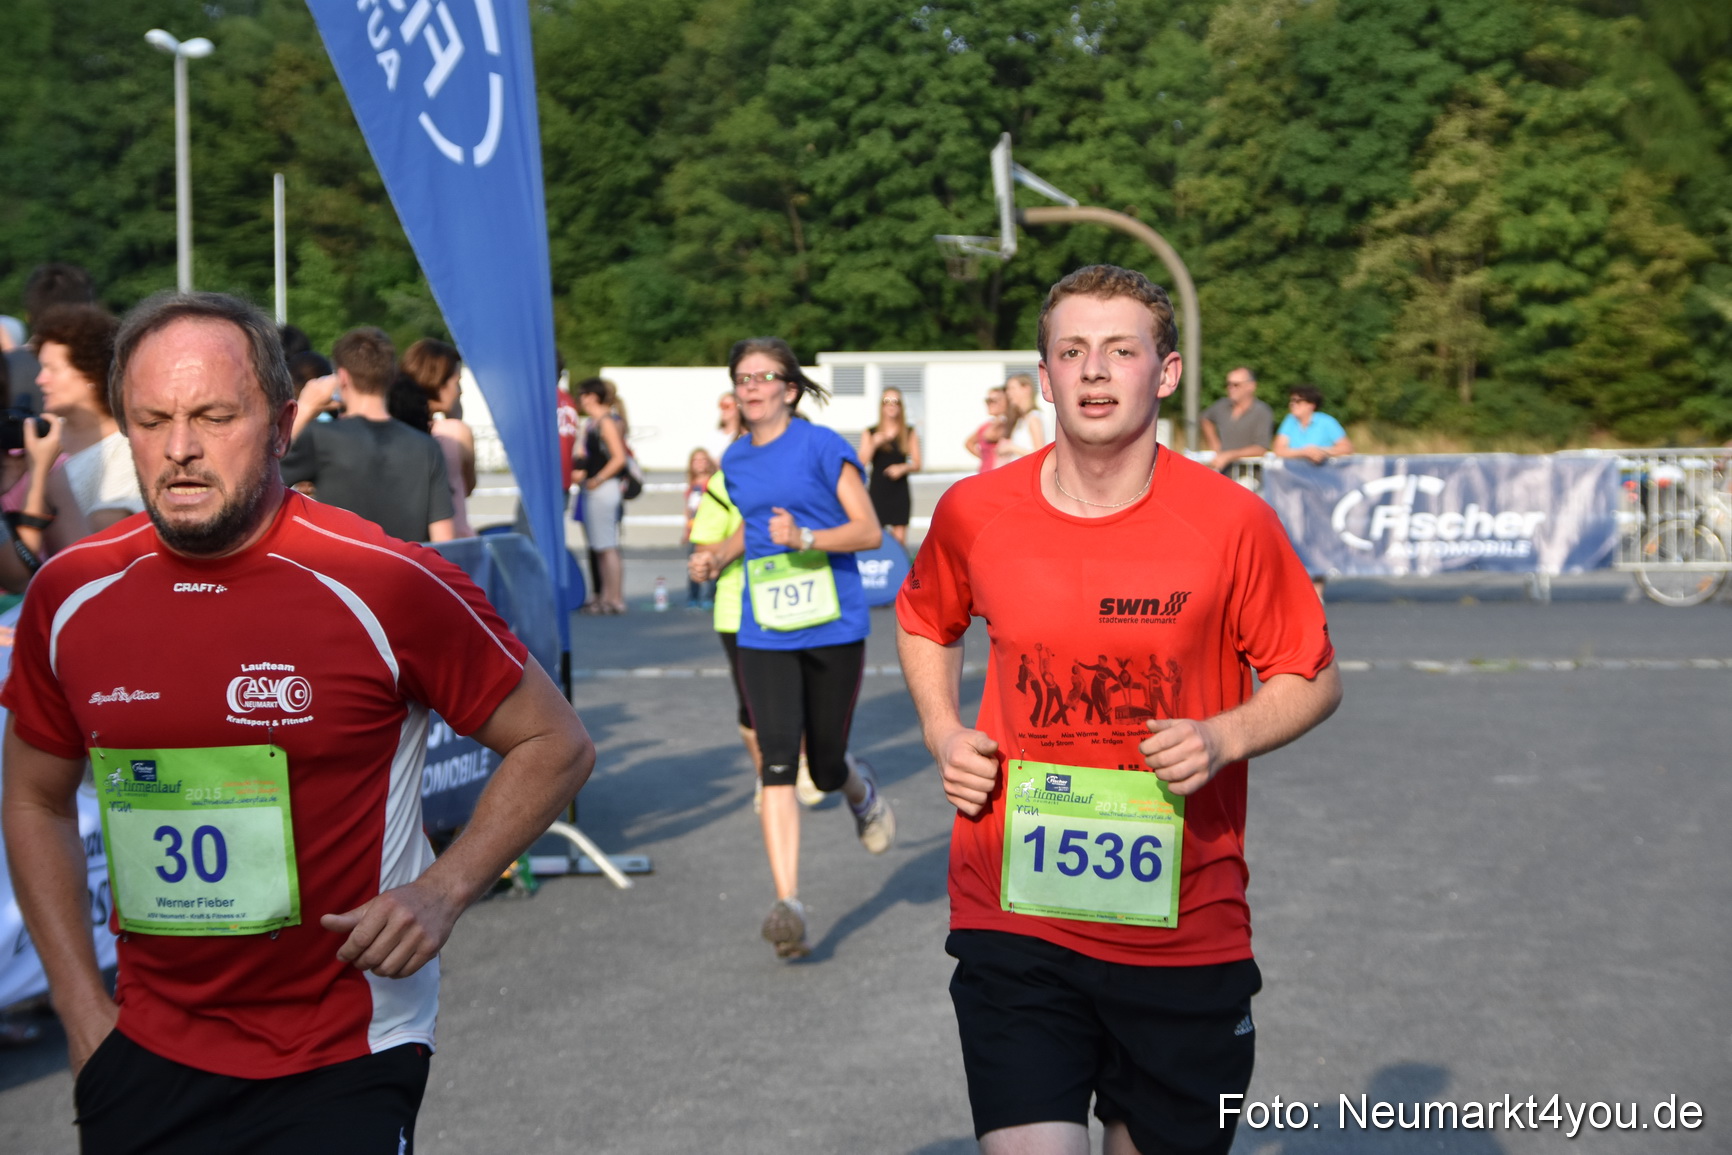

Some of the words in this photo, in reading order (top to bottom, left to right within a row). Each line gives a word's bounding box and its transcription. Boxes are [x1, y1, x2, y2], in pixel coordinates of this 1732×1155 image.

[1370, 502, 1546, 540] Fischer
[1387, 539, 1532, 558] AUTOMOBILE
[173, 582, 215, 593] CRAFT
[768, 580, 815, 610] 797
[1098, 598, 1160, 616] swn
[1098, 616, 1139, 624] stadtwerke
[1140, 616, 1177, 625] neumarkt
[240, 661, 295, 673] Laufteam
[246, 676, 280, 700] ASV
[244, 700, 278, 708] NEUMARKT
[225, 714, 270, 727] Kraftsport
[271, 719, 279, 727] &
[281, 714, 314, 726] Fitness
[1040, 740, 1055, 748] Lady
[1102, 737, 1124, 746] Erdgas
[420, 746, 491, 799] OMOBILE
[123, 779, 183, 793] firmenlauf
[185, 787, 222, 800] 2015
[1033, 788, 1095, 804] firmenlauf
[1094, 800, 1128, 813] 2015
[152, 824, 229, 884] 30
[1024, 825, 1163, 883] 1536
[156, 896, 195, 908] Werner
[197, 896, 235, 908] Fieber
